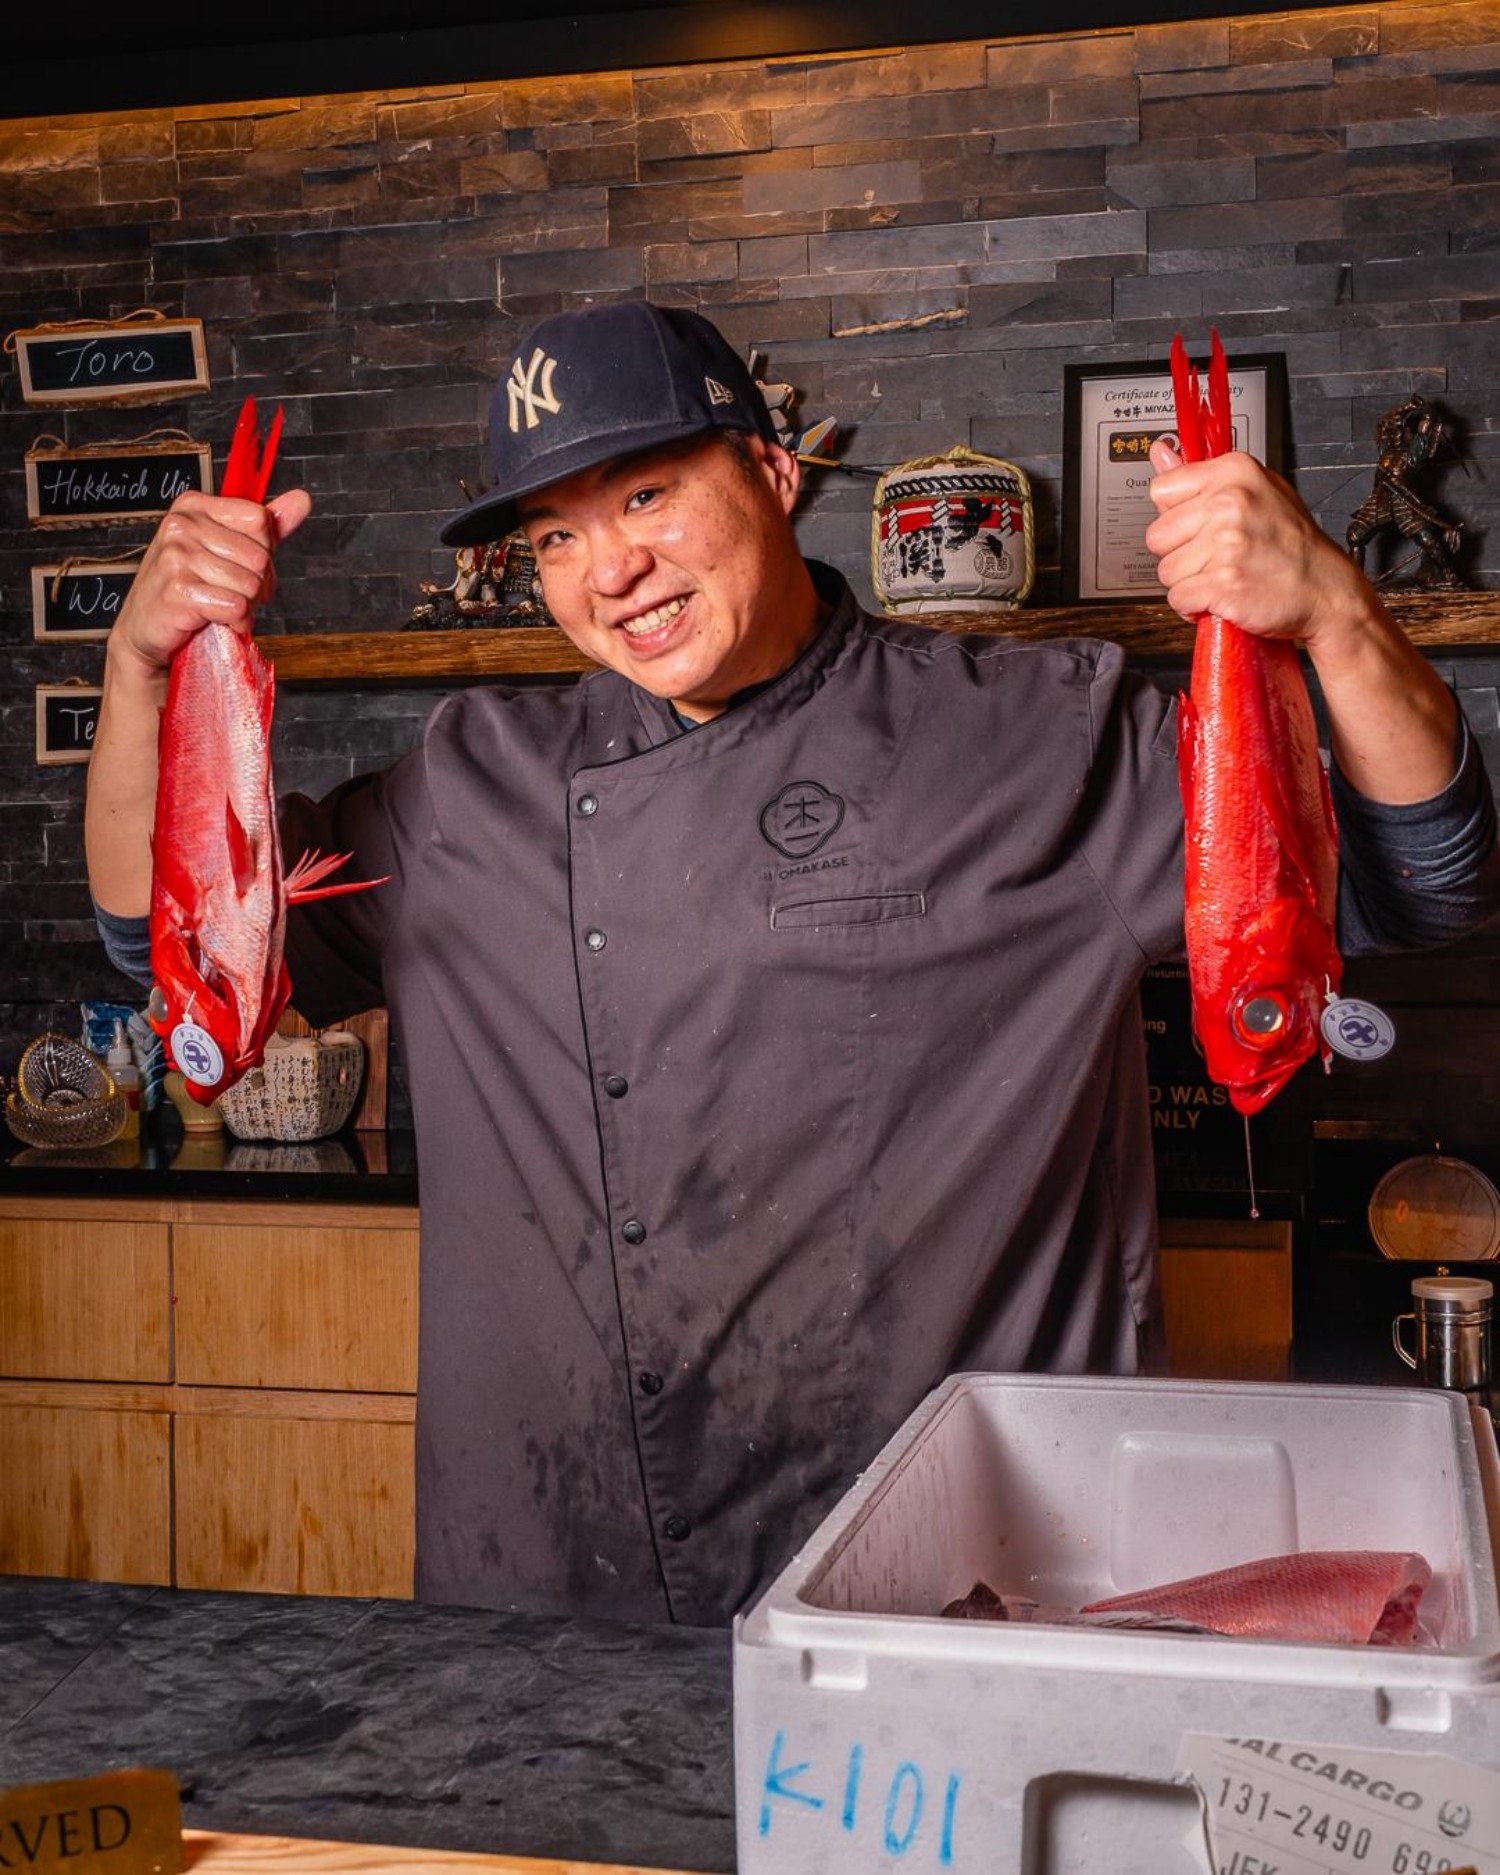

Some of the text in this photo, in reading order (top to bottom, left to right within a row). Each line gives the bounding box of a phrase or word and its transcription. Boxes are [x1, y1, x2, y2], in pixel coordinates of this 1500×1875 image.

[56, 340, 154, 382] Toro
[506, 347, 562, 433] NY
[1105, 385, 1174, 403] Certificate of
[1145, 404, 1178, 414] MIYAZ
[44, 468, 191, 505] Hokkaido Uni
[59, 707, 94, 741] Te
[758, 1727, 964, 1868] K101
[1218, 1777, 1372, 1860] 131-2490
